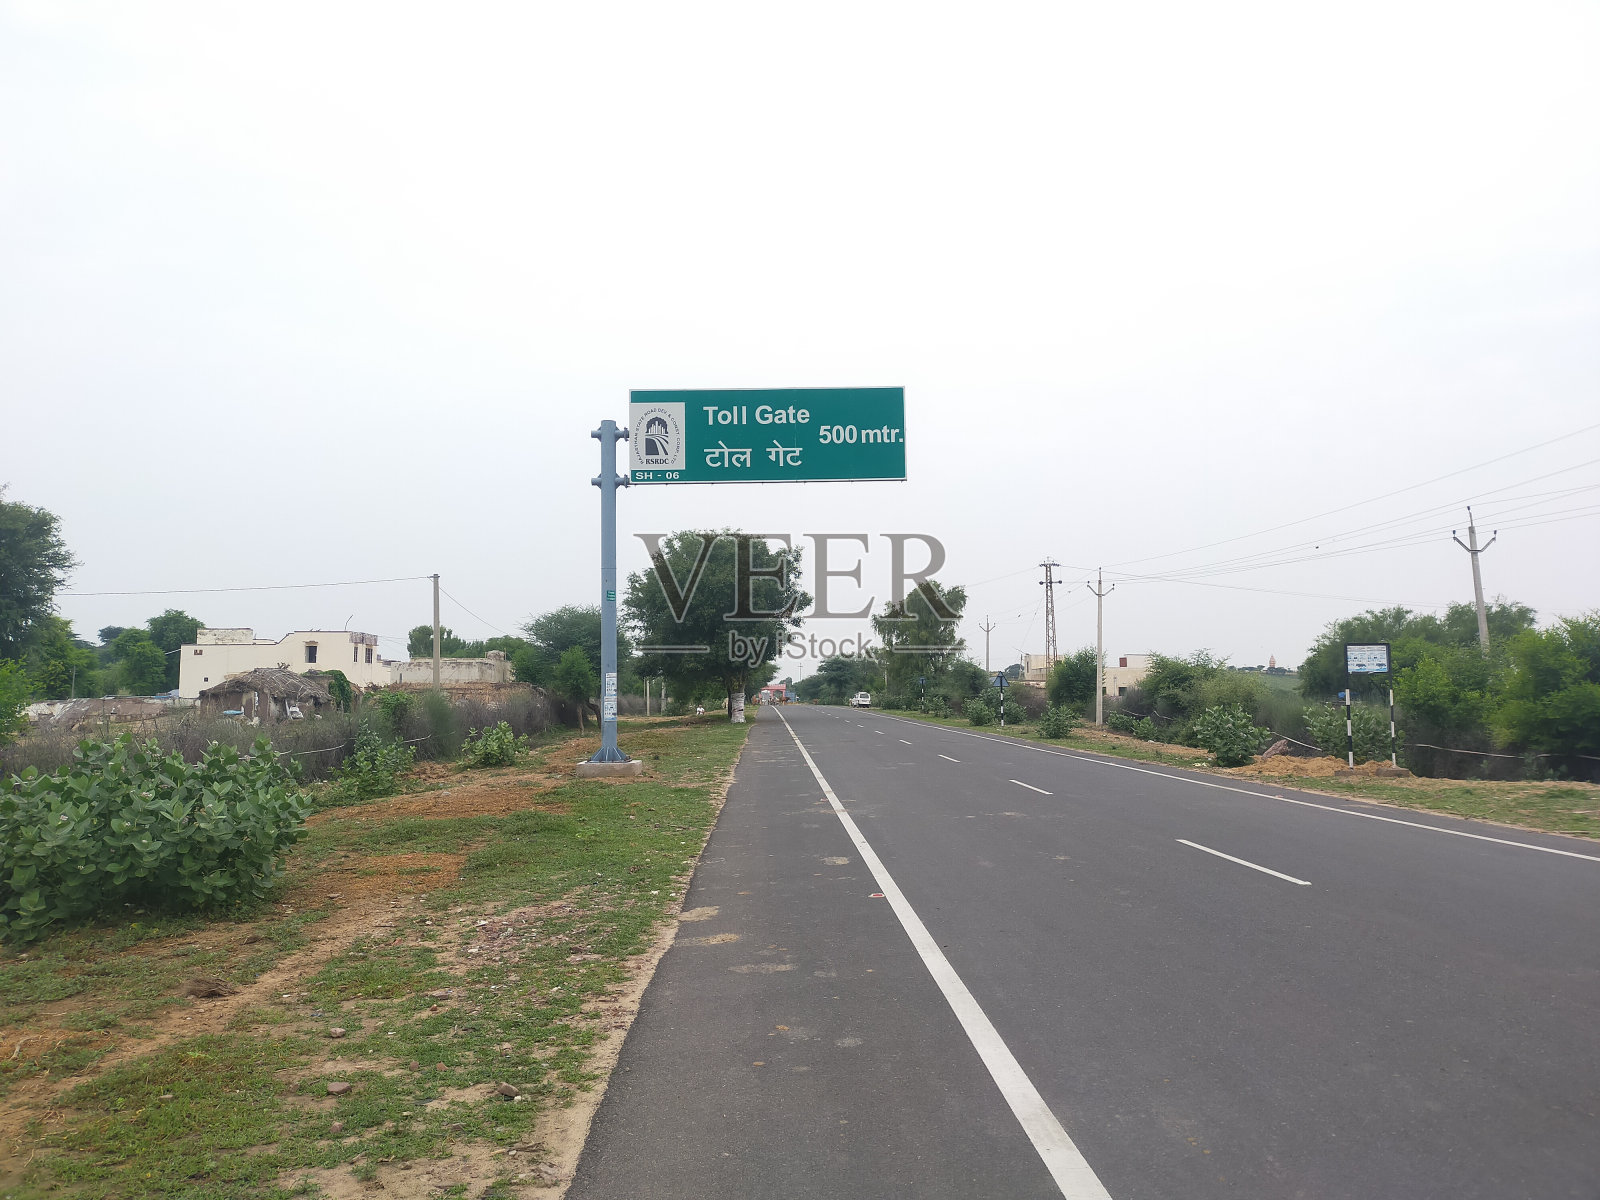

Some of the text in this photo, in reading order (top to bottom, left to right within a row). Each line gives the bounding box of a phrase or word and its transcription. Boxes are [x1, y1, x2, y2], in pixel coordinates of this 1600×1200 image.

[703, 405, 810, 425] Toll Gate
[818, 425, 904, 444] 500 mtr.
[703, 439, 803, 468] टोल गेट
[635, 472, 653, 480] SH
[666, 472, 680, 480] 06
